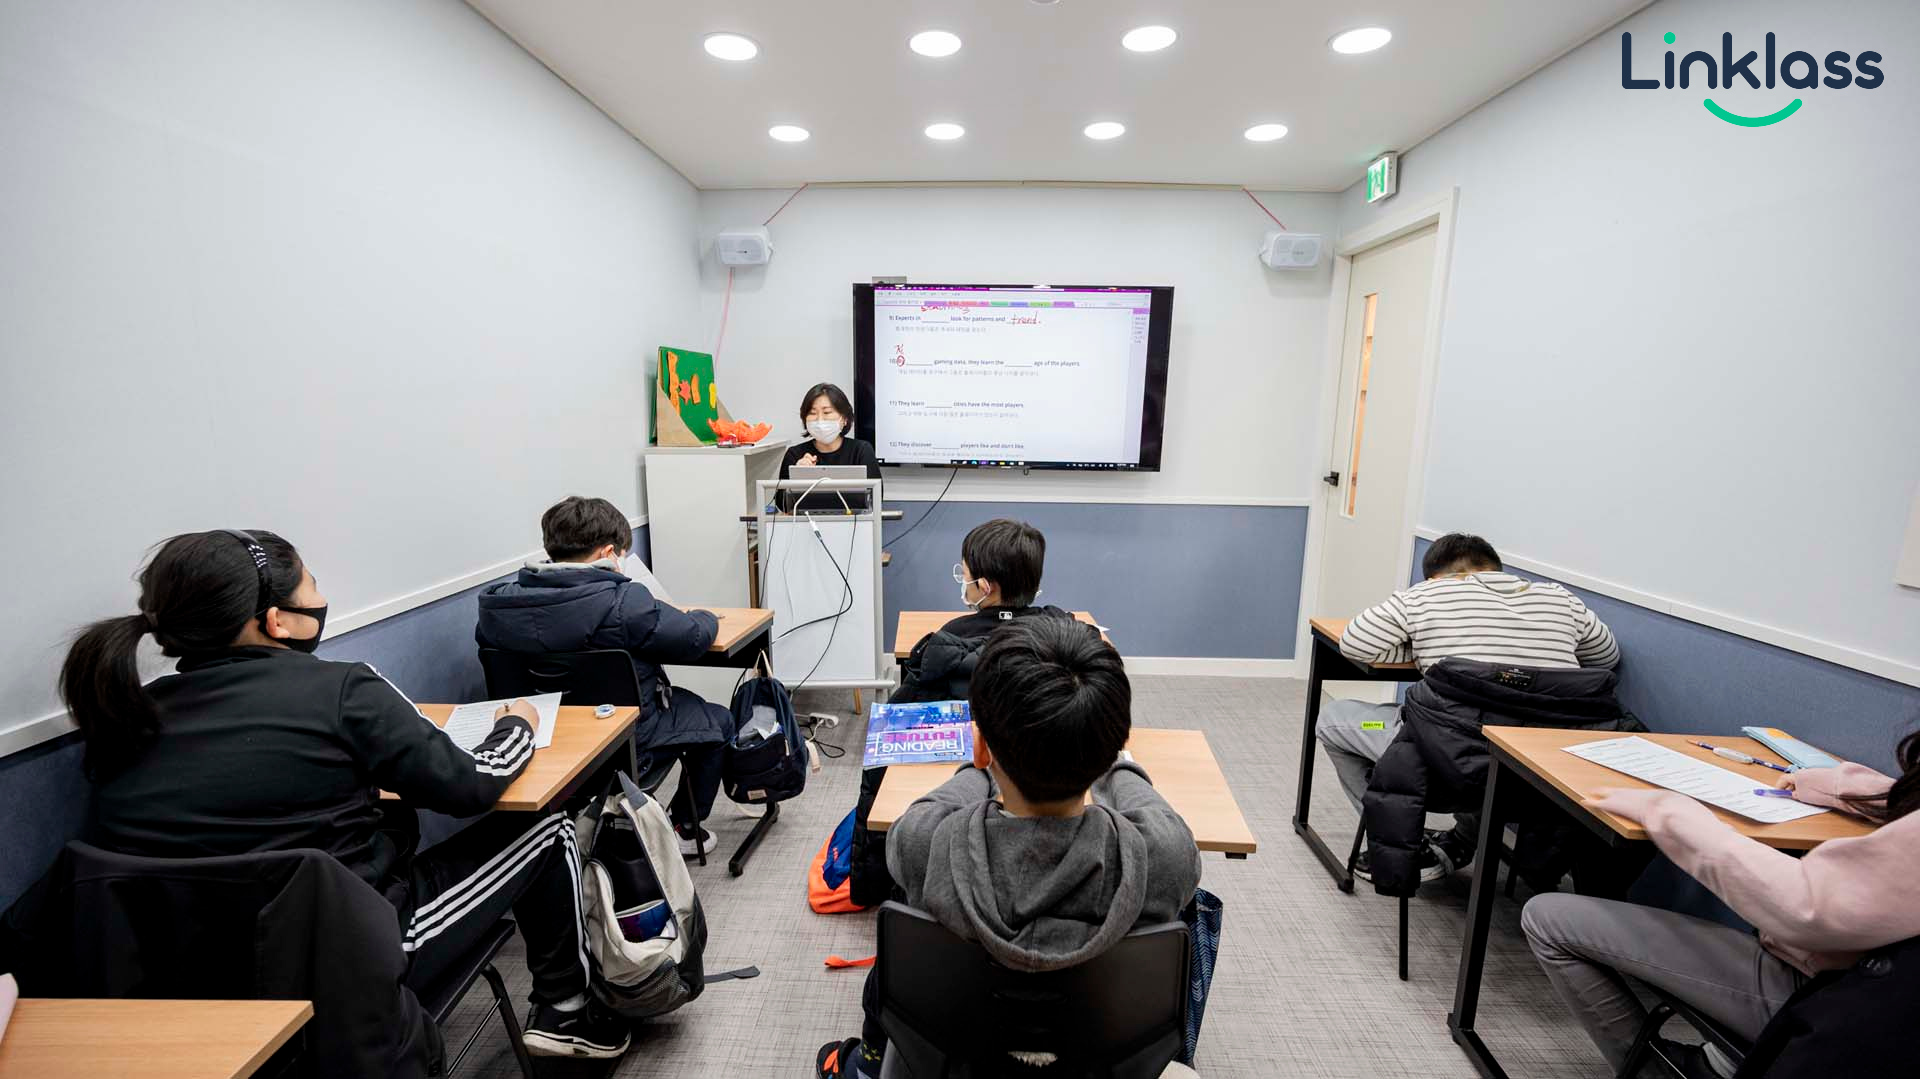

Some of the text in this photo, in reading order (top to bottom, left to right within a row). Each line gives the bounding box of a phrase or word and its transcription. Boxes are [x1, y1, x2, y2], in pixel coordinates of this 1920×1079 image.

[896, 315, 915, 323] Experts
[972, 315, 994, 323] patterns
[898, 400, 910, 408] They
[898, 441, 910, 449] They
[881, 739, 959, 753] READING
